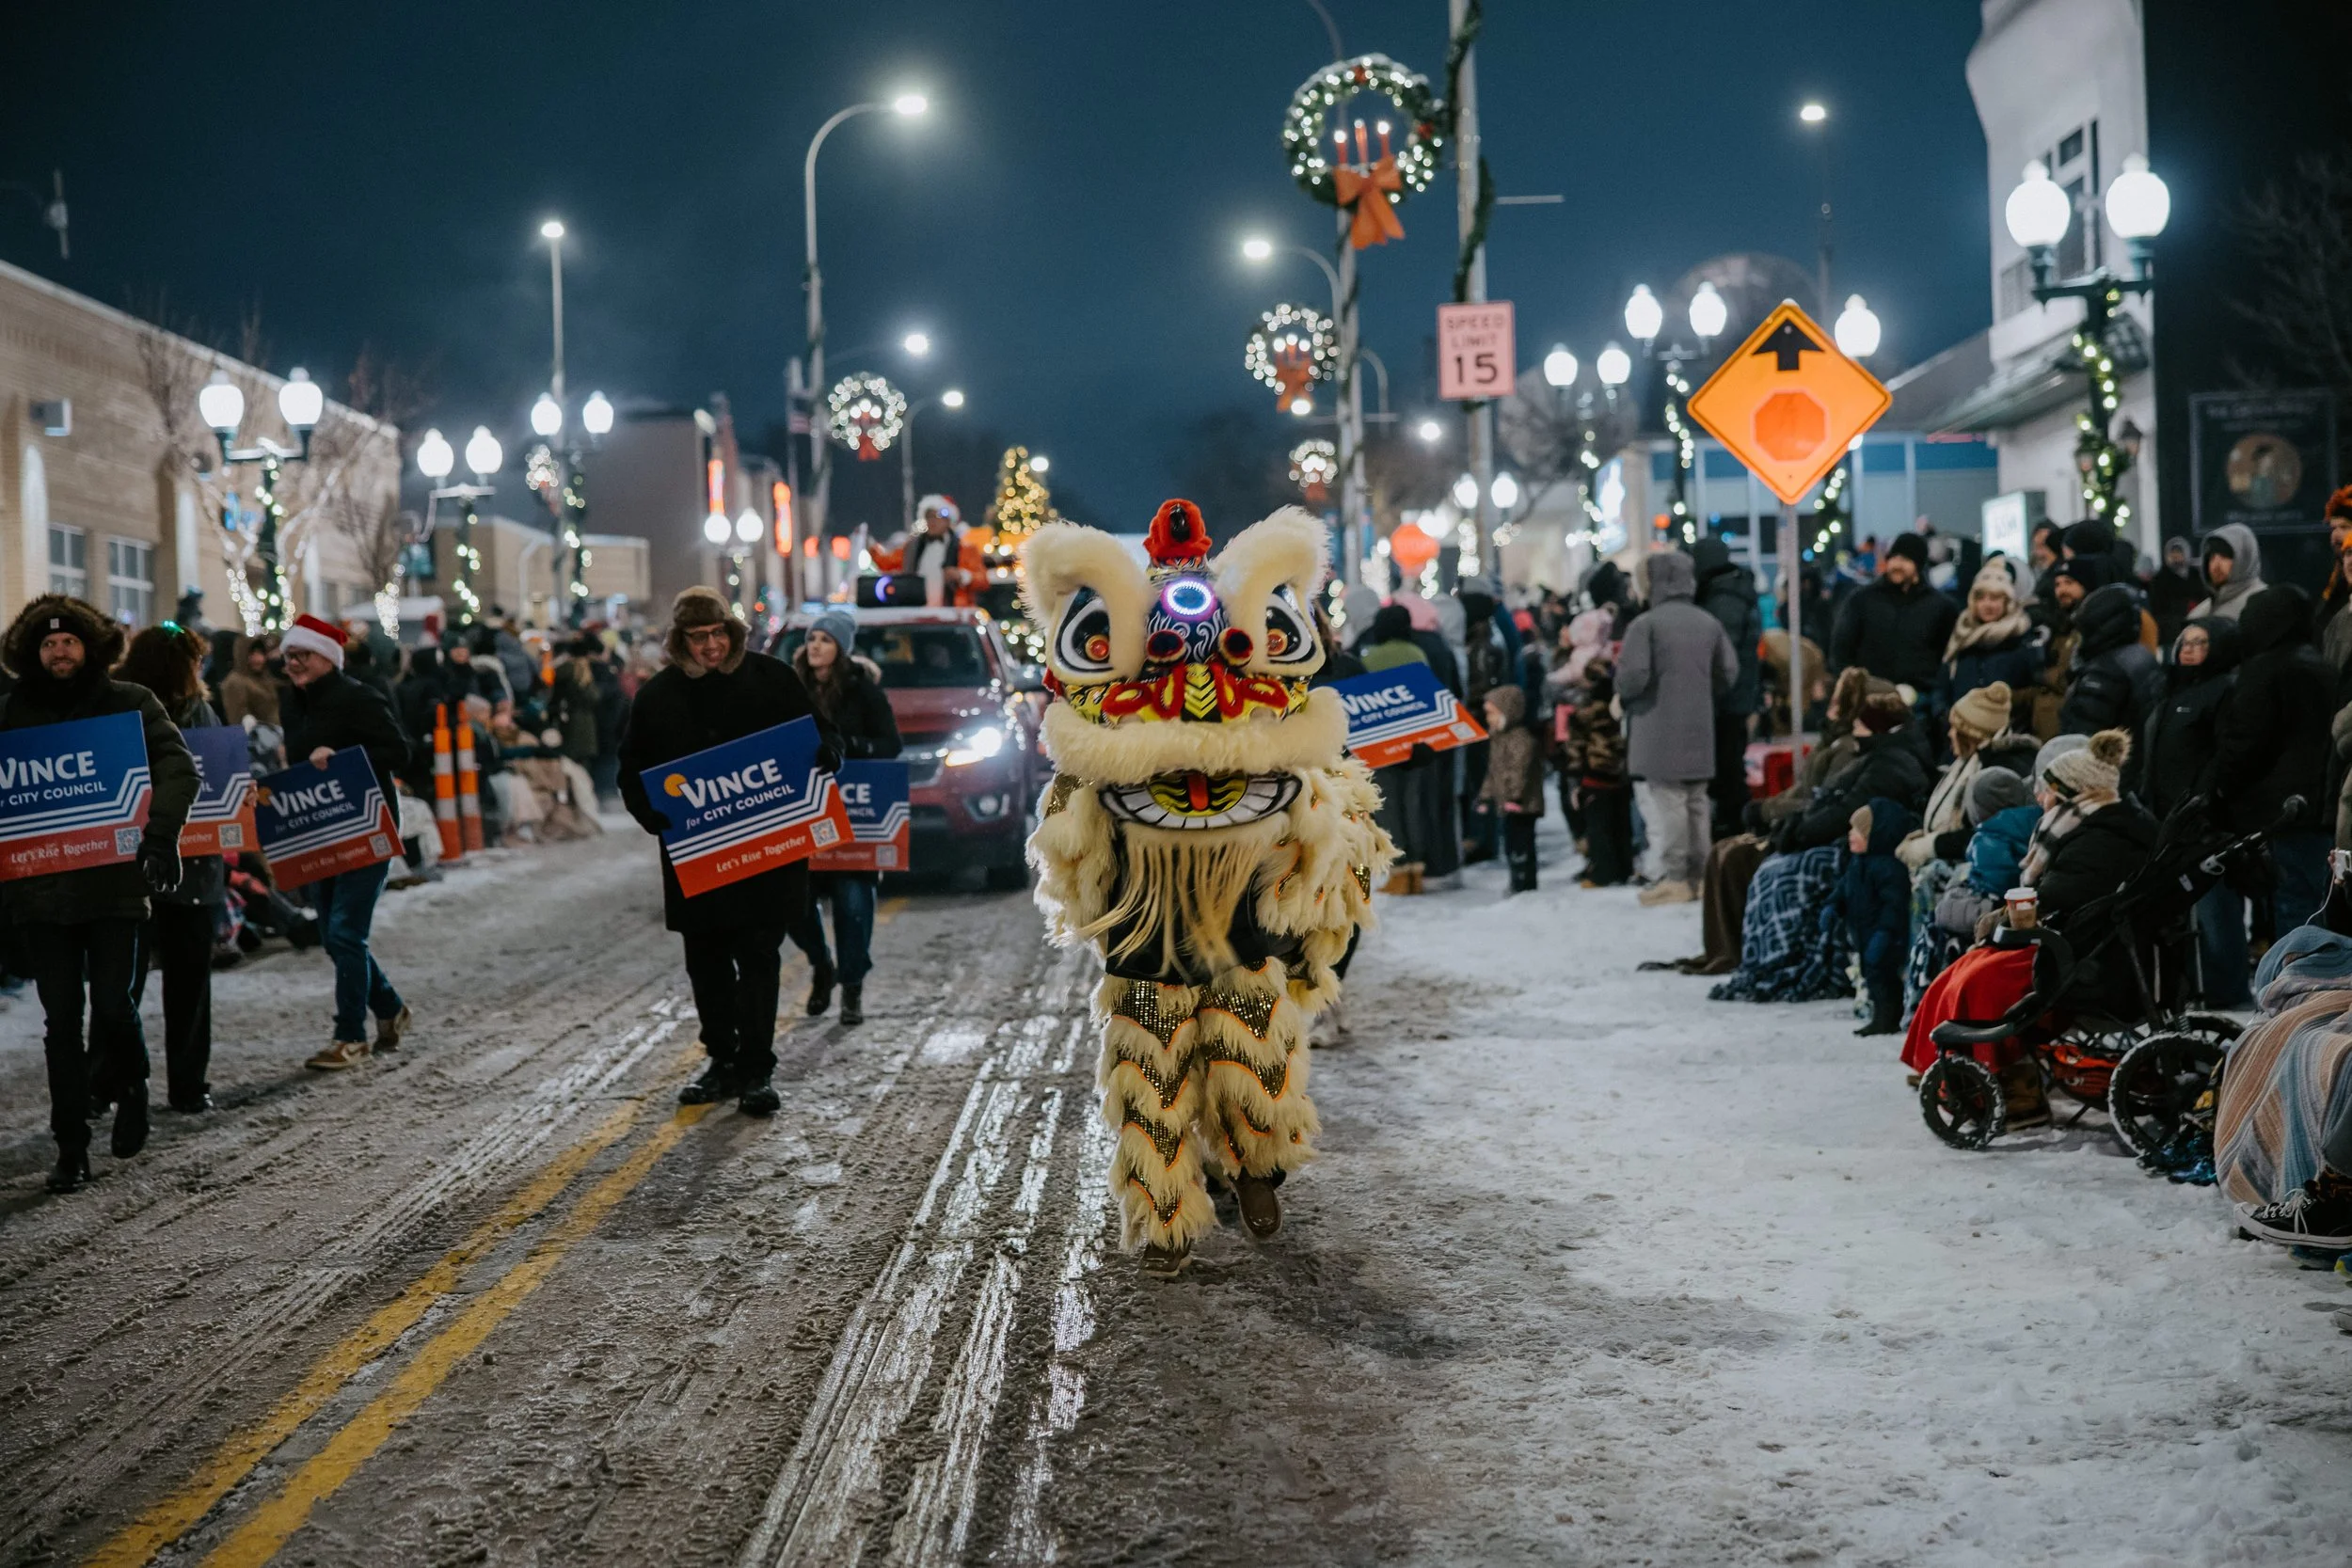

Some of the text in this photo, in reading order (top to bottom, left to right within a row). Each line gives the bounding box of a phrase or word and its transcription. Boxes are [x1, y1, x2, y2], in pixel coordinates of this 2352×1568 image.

[1446, 313, 1504, 332] SPEED
[1451, 333, 1497, 350] LIMIT
[1455, 353, 1498, 385] 15
[1341, 685, 1415, 715] VINCE
[0, 751, 96, 789] VINCE
[678, 758, 783, 809] VINCE
[9, 792, 39, 806] CITY
[43, 781, 106, 800] COUNCIL
[268, 779, 345, 817] VINCE
[686, 784, 796, 831] for CITY COUNCIL
[288, 814, 310, 828] CITY
[311, 801, 357, 821] COUNCIL
[11, 840, 109, 863] Let's Rise Together
[716, 835, 806, 873] Let's Rise Together
